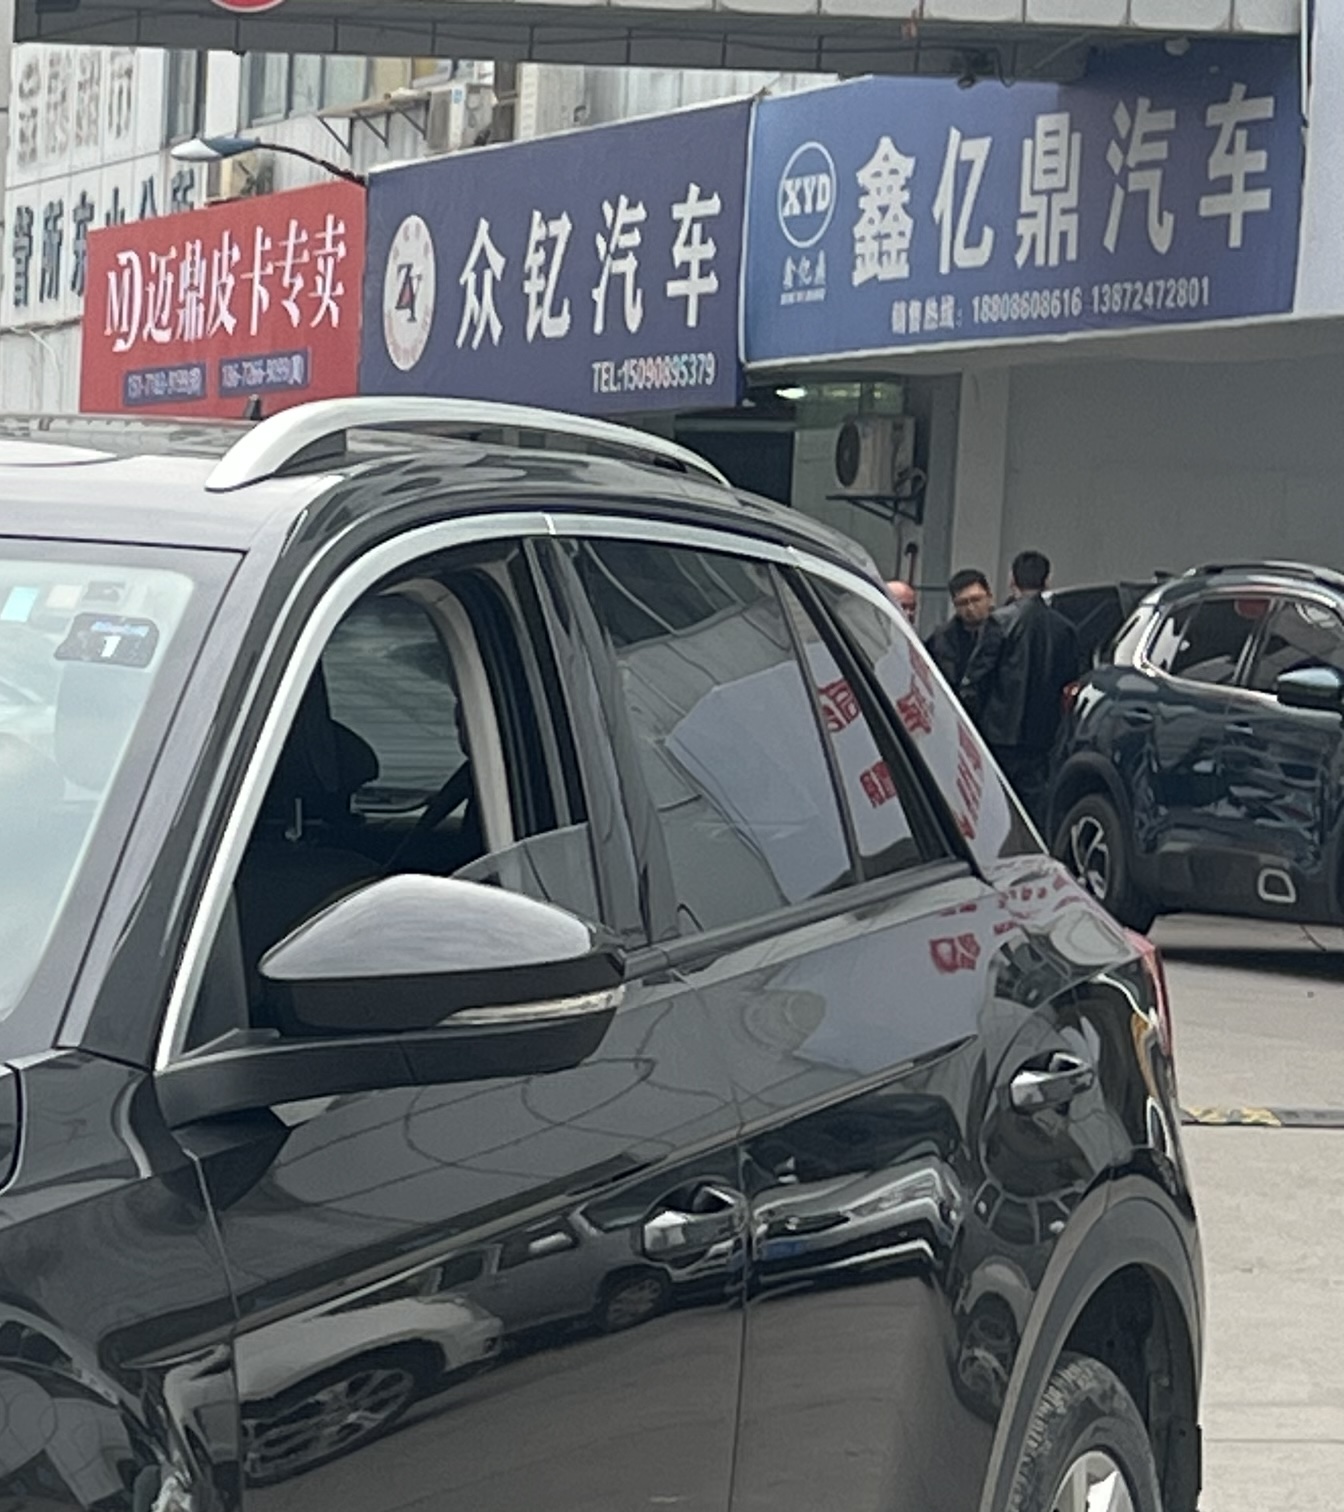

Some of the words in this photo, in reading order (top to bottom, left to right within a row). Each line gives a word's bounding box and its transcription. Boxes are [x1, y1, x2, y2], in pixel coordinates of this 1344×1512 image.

[781, 172, 831, 219] XYD
[852, 81, 1275, 287] 鑫亿鼎汽车
[456, 182, 722, 350] 众钇汽车
[1091, 275, 1210, 315] 13872472801
